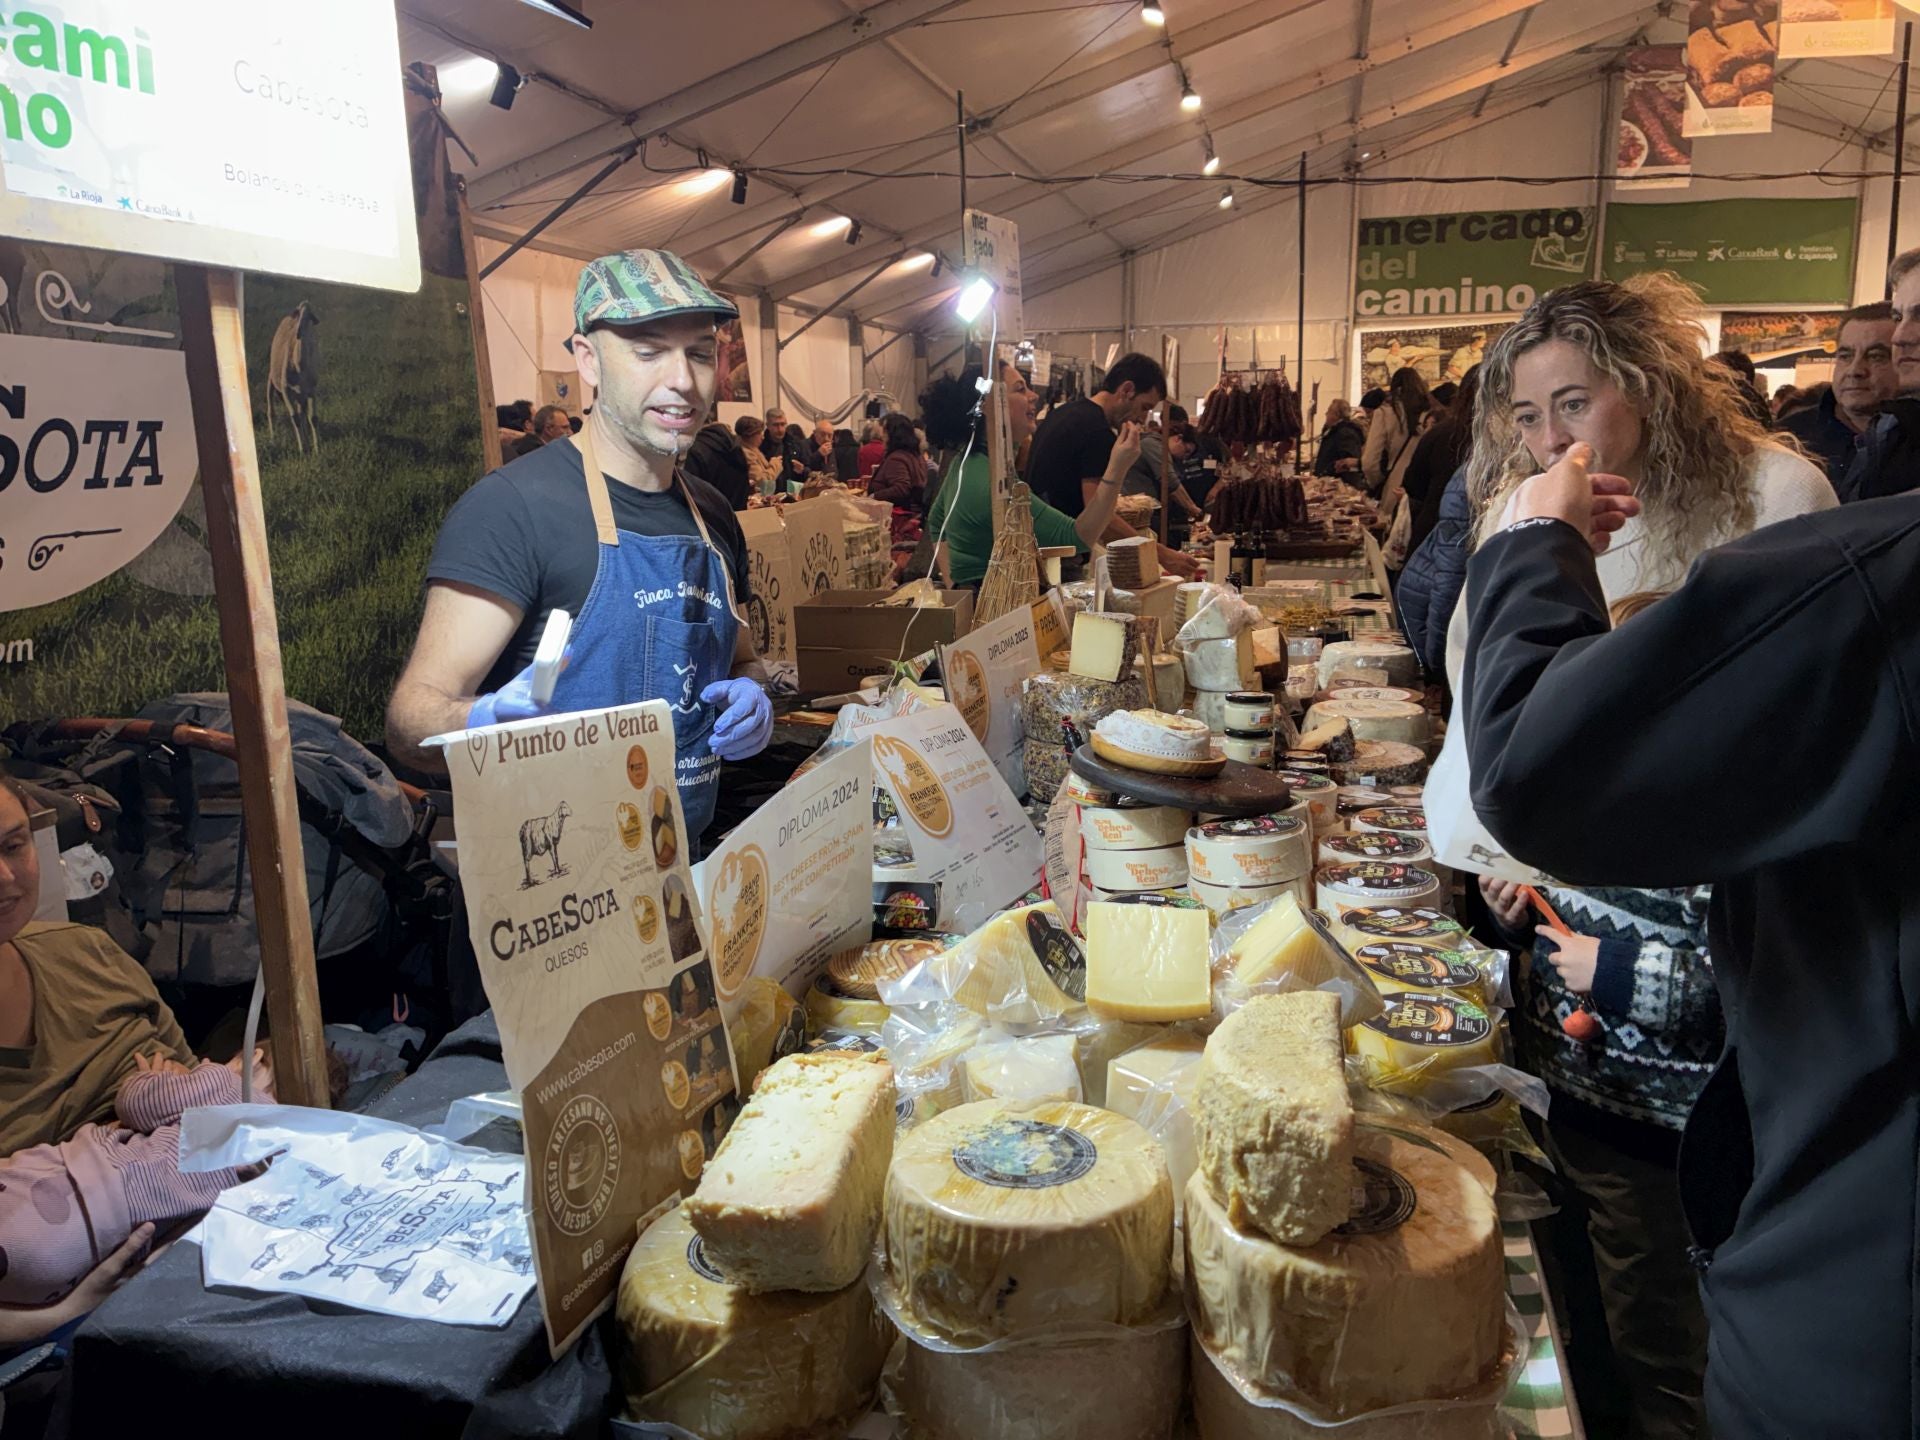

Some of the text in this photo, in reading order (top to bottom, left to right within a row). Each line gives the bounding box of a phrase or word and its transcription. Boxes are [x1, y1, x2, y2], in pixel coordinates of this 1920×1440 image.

[0, 11, 155, 95] ami
[70, 189, 103, 204] La Rioja
[1359, 208, 1584, 246] mercado
[1358, 250, 1416, 281] del
[1728, 247, 1780, 258] CaixaBank
[1356, 277, 1536, 316] camino
[801, 532, 839, 590] ZEBERIO
[633, 588, 674, 609] Finca
[988, 635, 1015, 661] DIPLOMA
[498, 707, 660, 764] Punto de Venta
[948, 727, 968, 745] 2024
[909, 783, 941, 803] FRANKFURT
[778, 777, 860, 848] DIPLOMA 2024
[790, 852, 818, 881] CHEESE
[819, 836, 841, 860] FROM
[843, 822, 865, 845] SPAIN
[740, 873, 760, 901] GRAND
[790, 881, 805, 897] THE
[804, 844, 856, 887] COMPETITION
[1131, 866, 1169, 876] Dehesa
[1136, 874, 1158, 883] Real
[744, 883, 760, 905] GOLD
[723, 904, 763, 958] FRANKFURT
[545, 942, 589, 973] QUESOS
[536, 1031, 637, 1105] www.cabesota.com
[547, 1101, 619, 1213] QUESO ARTESANO DE OVEJA
[563, 1182, 611, 1230] DESDE 1948
